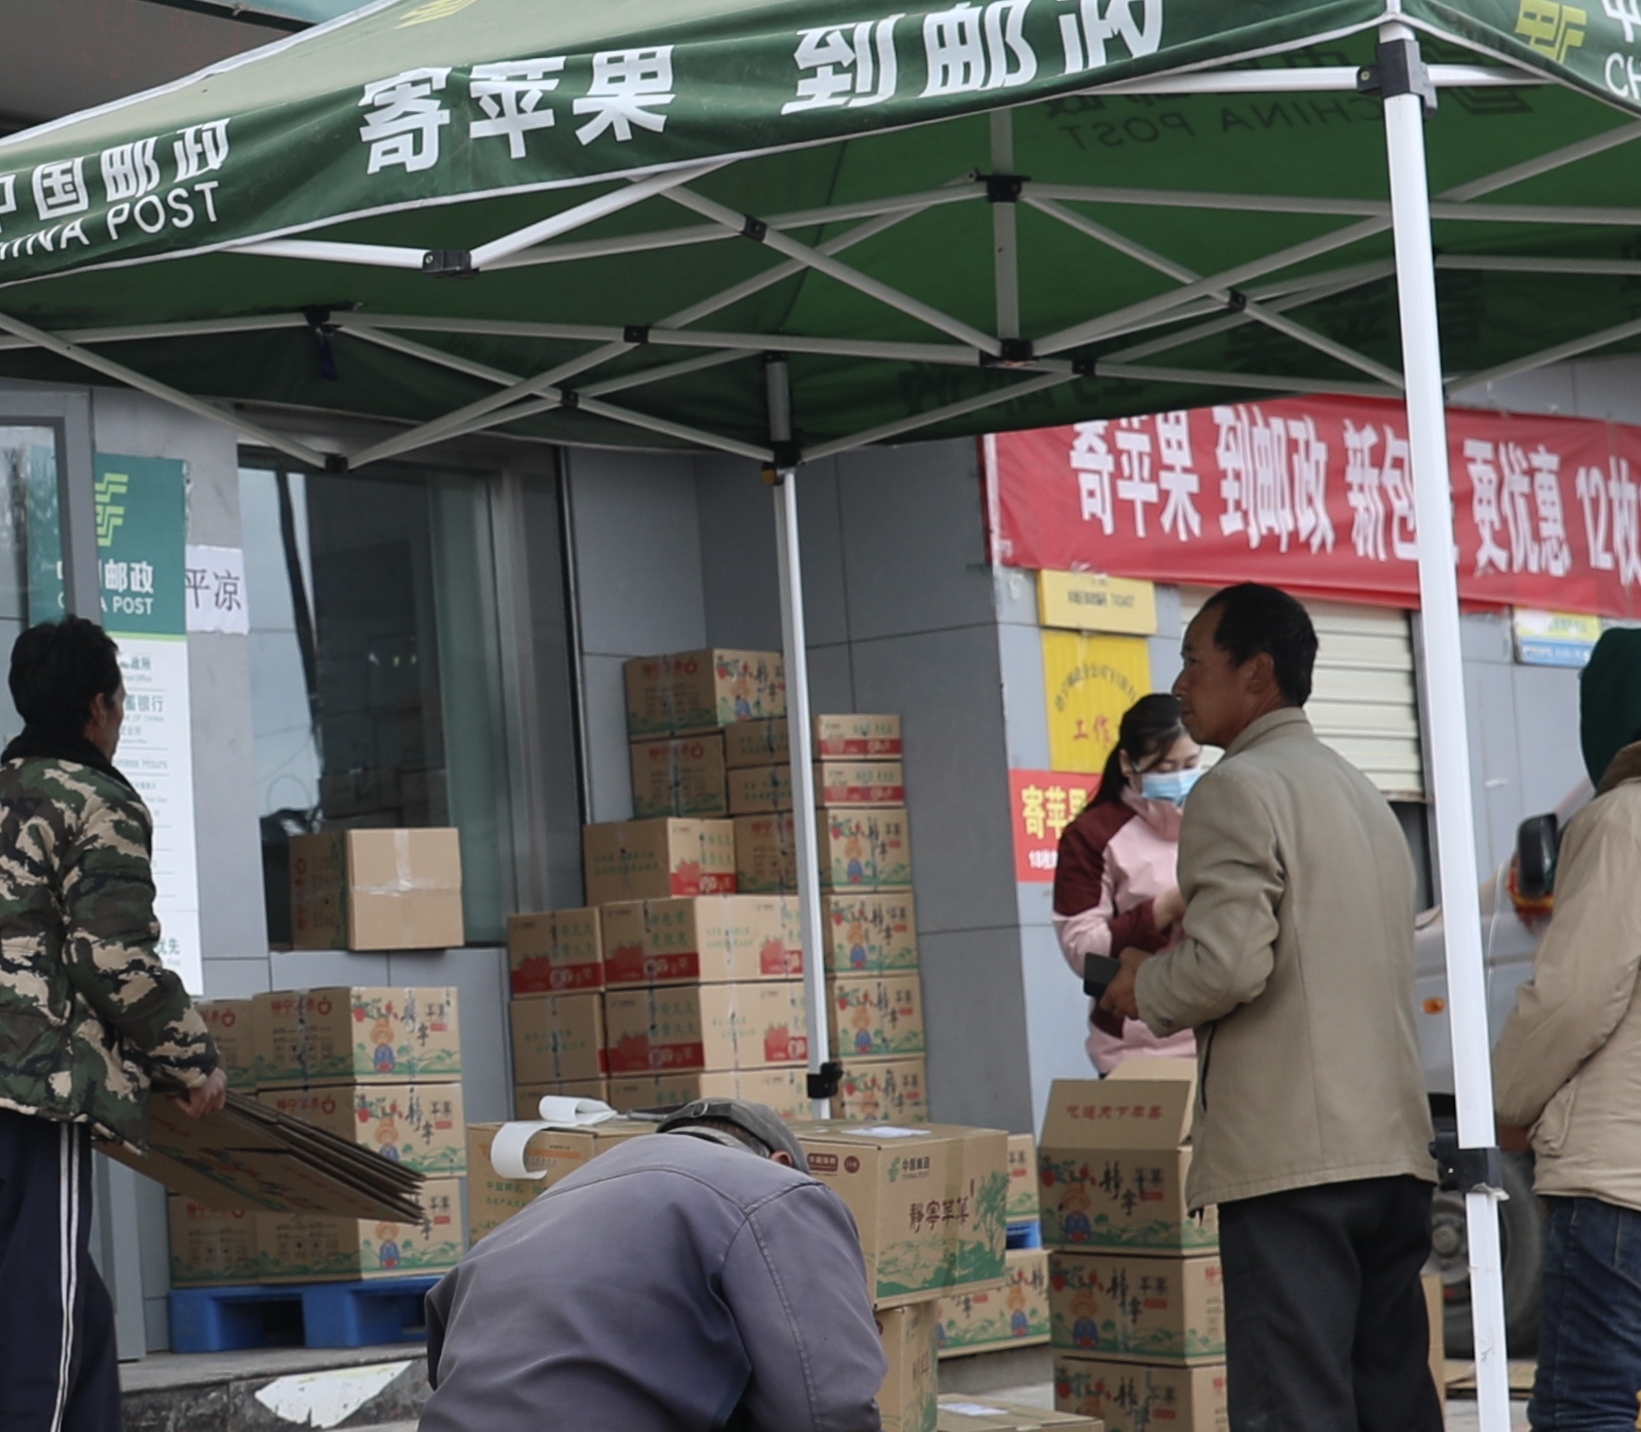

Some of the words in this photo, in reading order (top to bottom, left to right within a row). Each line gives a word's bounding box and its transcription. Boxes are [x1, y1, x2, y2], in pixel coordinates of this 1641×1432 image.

[358, 44, 676, 174] 寄苹果
[106, 179, 225, 242] POST
[1213, 402, 1336, 556] 到邮政
[1462, 438, 1574, 578] 更优惠
[111, 595, 153, 616] POST
[185, 568, 243, 612] 平凉
